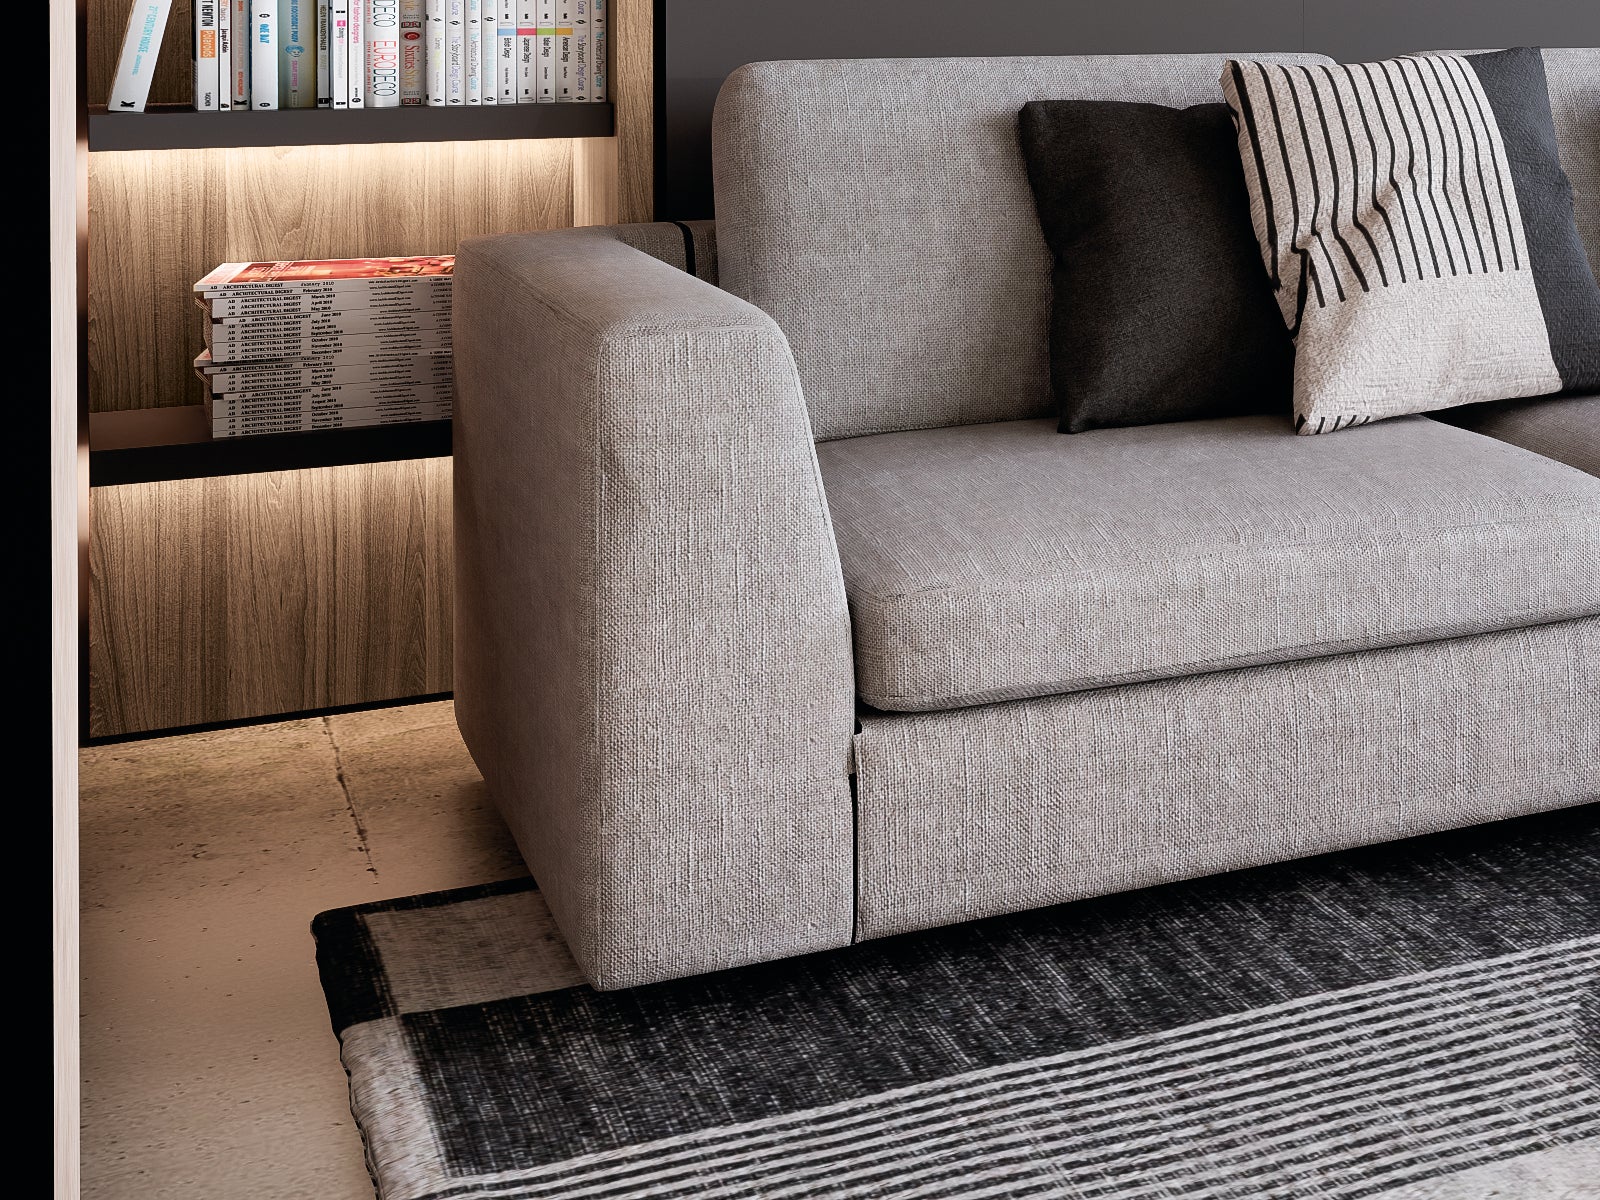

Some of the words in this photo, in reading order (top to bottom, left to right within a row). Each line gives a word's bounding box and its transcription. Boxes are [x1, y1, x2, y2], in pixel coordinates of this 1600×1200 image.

[201, 4, 214, 27] NEWTON
[202, 29, 215, 58] Polaroids
[373, 39, 395, 97] EURODECO
[404, 44, 420, 70] Sixties
[251, 315, 294, 323] ARCHITECTURAL
